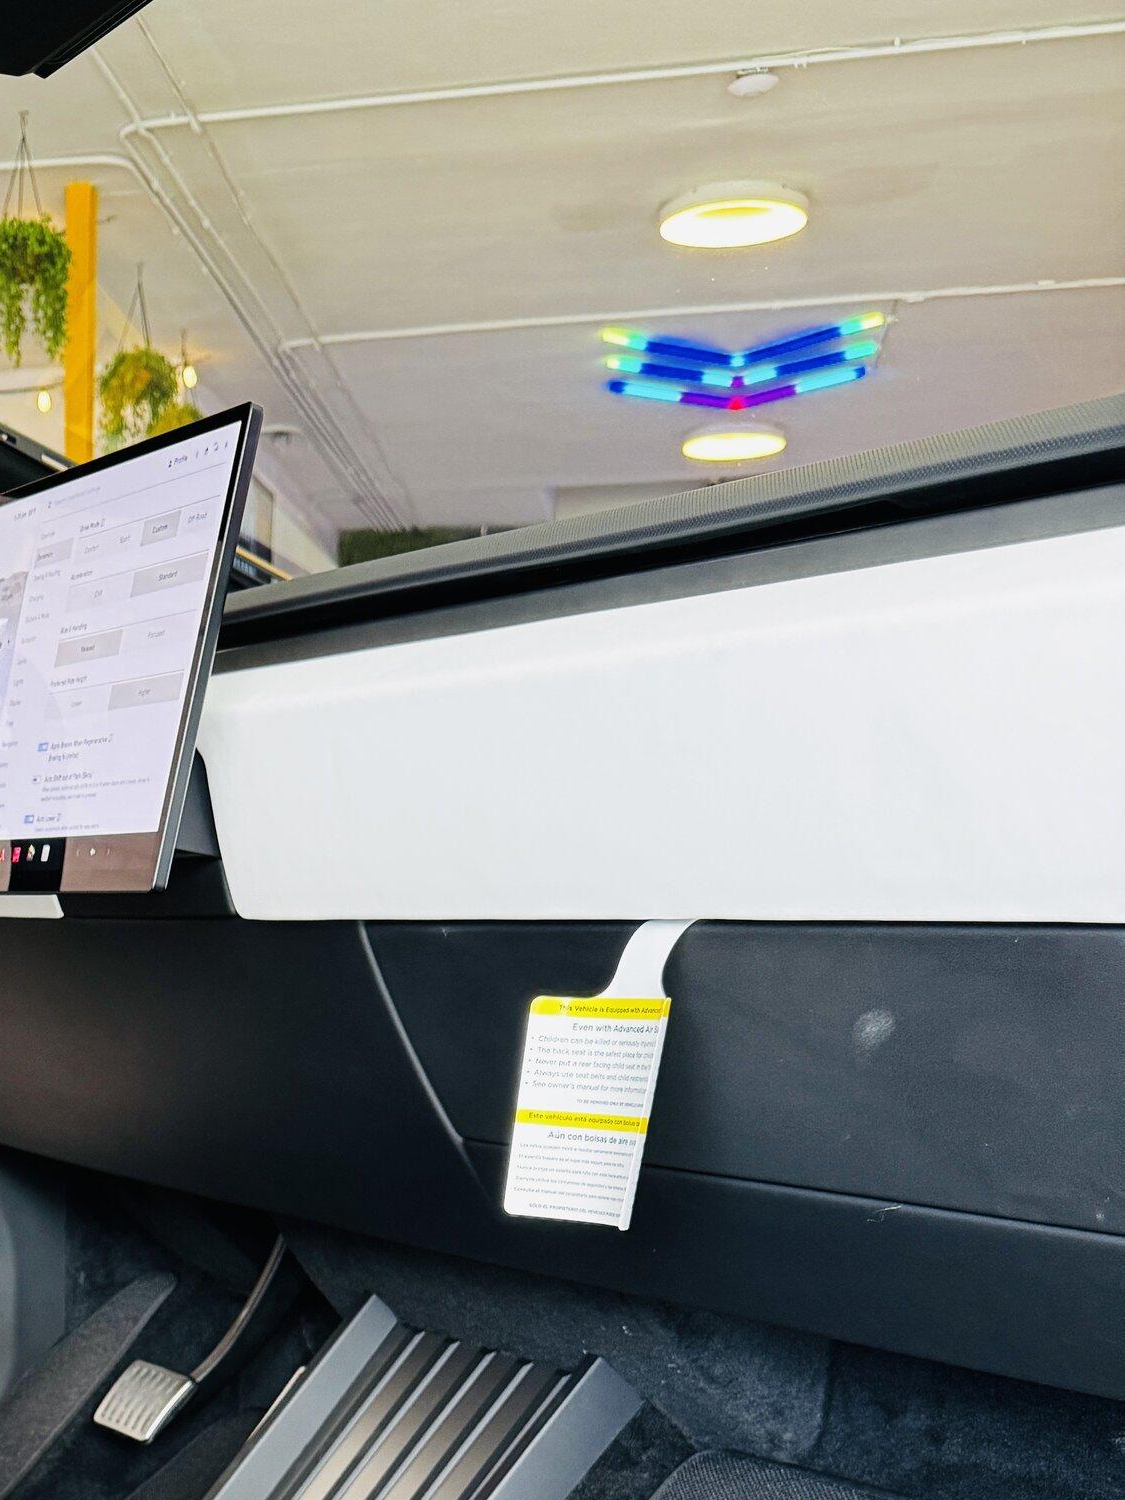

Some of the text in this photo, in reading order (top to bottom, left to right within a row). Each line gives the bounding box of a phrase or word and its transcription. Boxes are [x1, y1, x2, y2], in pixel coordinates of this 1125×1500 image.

[572, 1023, 594, 1031] Even
[596, 1024, 612, 1032] with
[613, 1024, 644, 1034] Advanced
[538, 1035, 569, 1044] Children
[584, 1037, 594, 1045] be
[538, 1046, 551, 1054] The
[548, 1131, 565, 1140] Aún
[567, 1133, 583, 1141] con
[584, 1135, 607, 1144] bolsas
